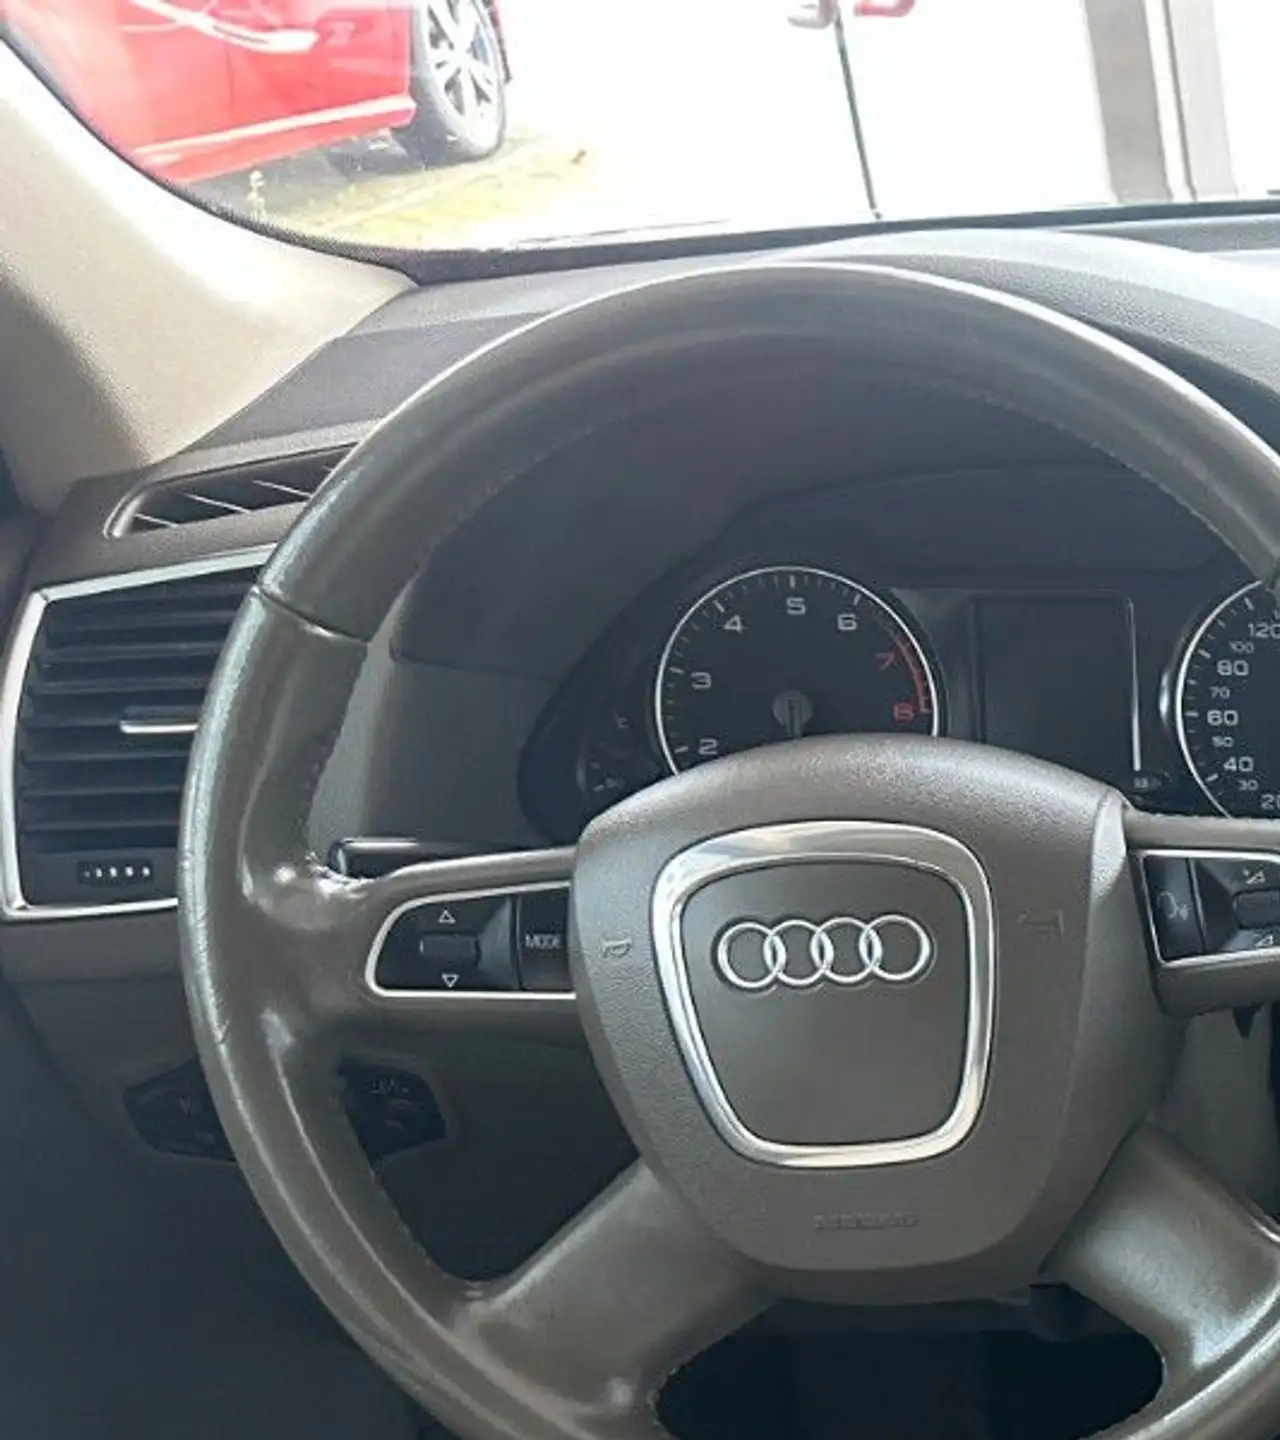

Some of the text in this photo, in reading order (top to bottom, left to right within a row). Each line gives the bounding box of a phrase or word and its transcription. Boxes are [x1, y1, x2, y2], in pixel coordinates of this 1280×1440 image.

[786, 597, 806, 615] 5
[724, 614, 744, 632] 4
[837, 614, 858, 631] 6
[1229, 641, 1254, 653] 100
[877, 652, 897, 669] 7
[1217, 660, 1249, 676] 80
[691, 671, 711, 689] 3
[1210, 687, 1230, 698] 70
[1207, 710, 1238, 726] 60
[699, 738, 718, 755] 2
[1223, 756, 1253, 772] 40
[1238, 780, 1258, 791] 30
[525, 932, 563, 951] MODE
